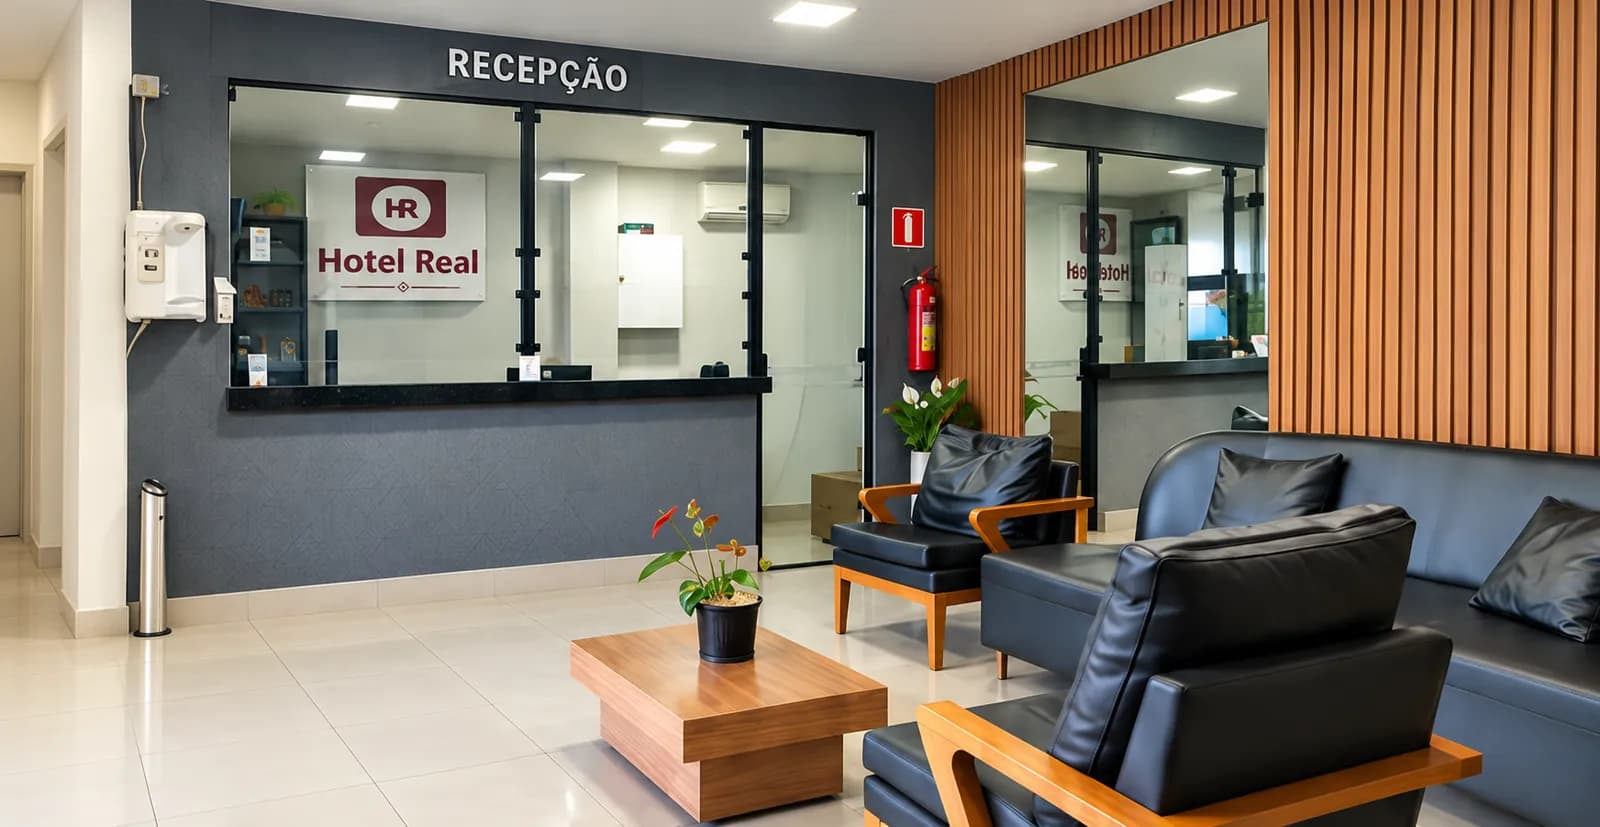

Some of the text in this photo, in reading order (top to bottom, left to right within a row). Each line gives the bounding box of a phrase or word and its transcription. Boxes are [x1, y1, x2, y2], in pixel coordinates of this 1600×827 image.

[448, 47, 628, 94] RECEPÇÃO
[385, 198, 419, 219] HR
[318, 247, 479, 274] Hotel Real
